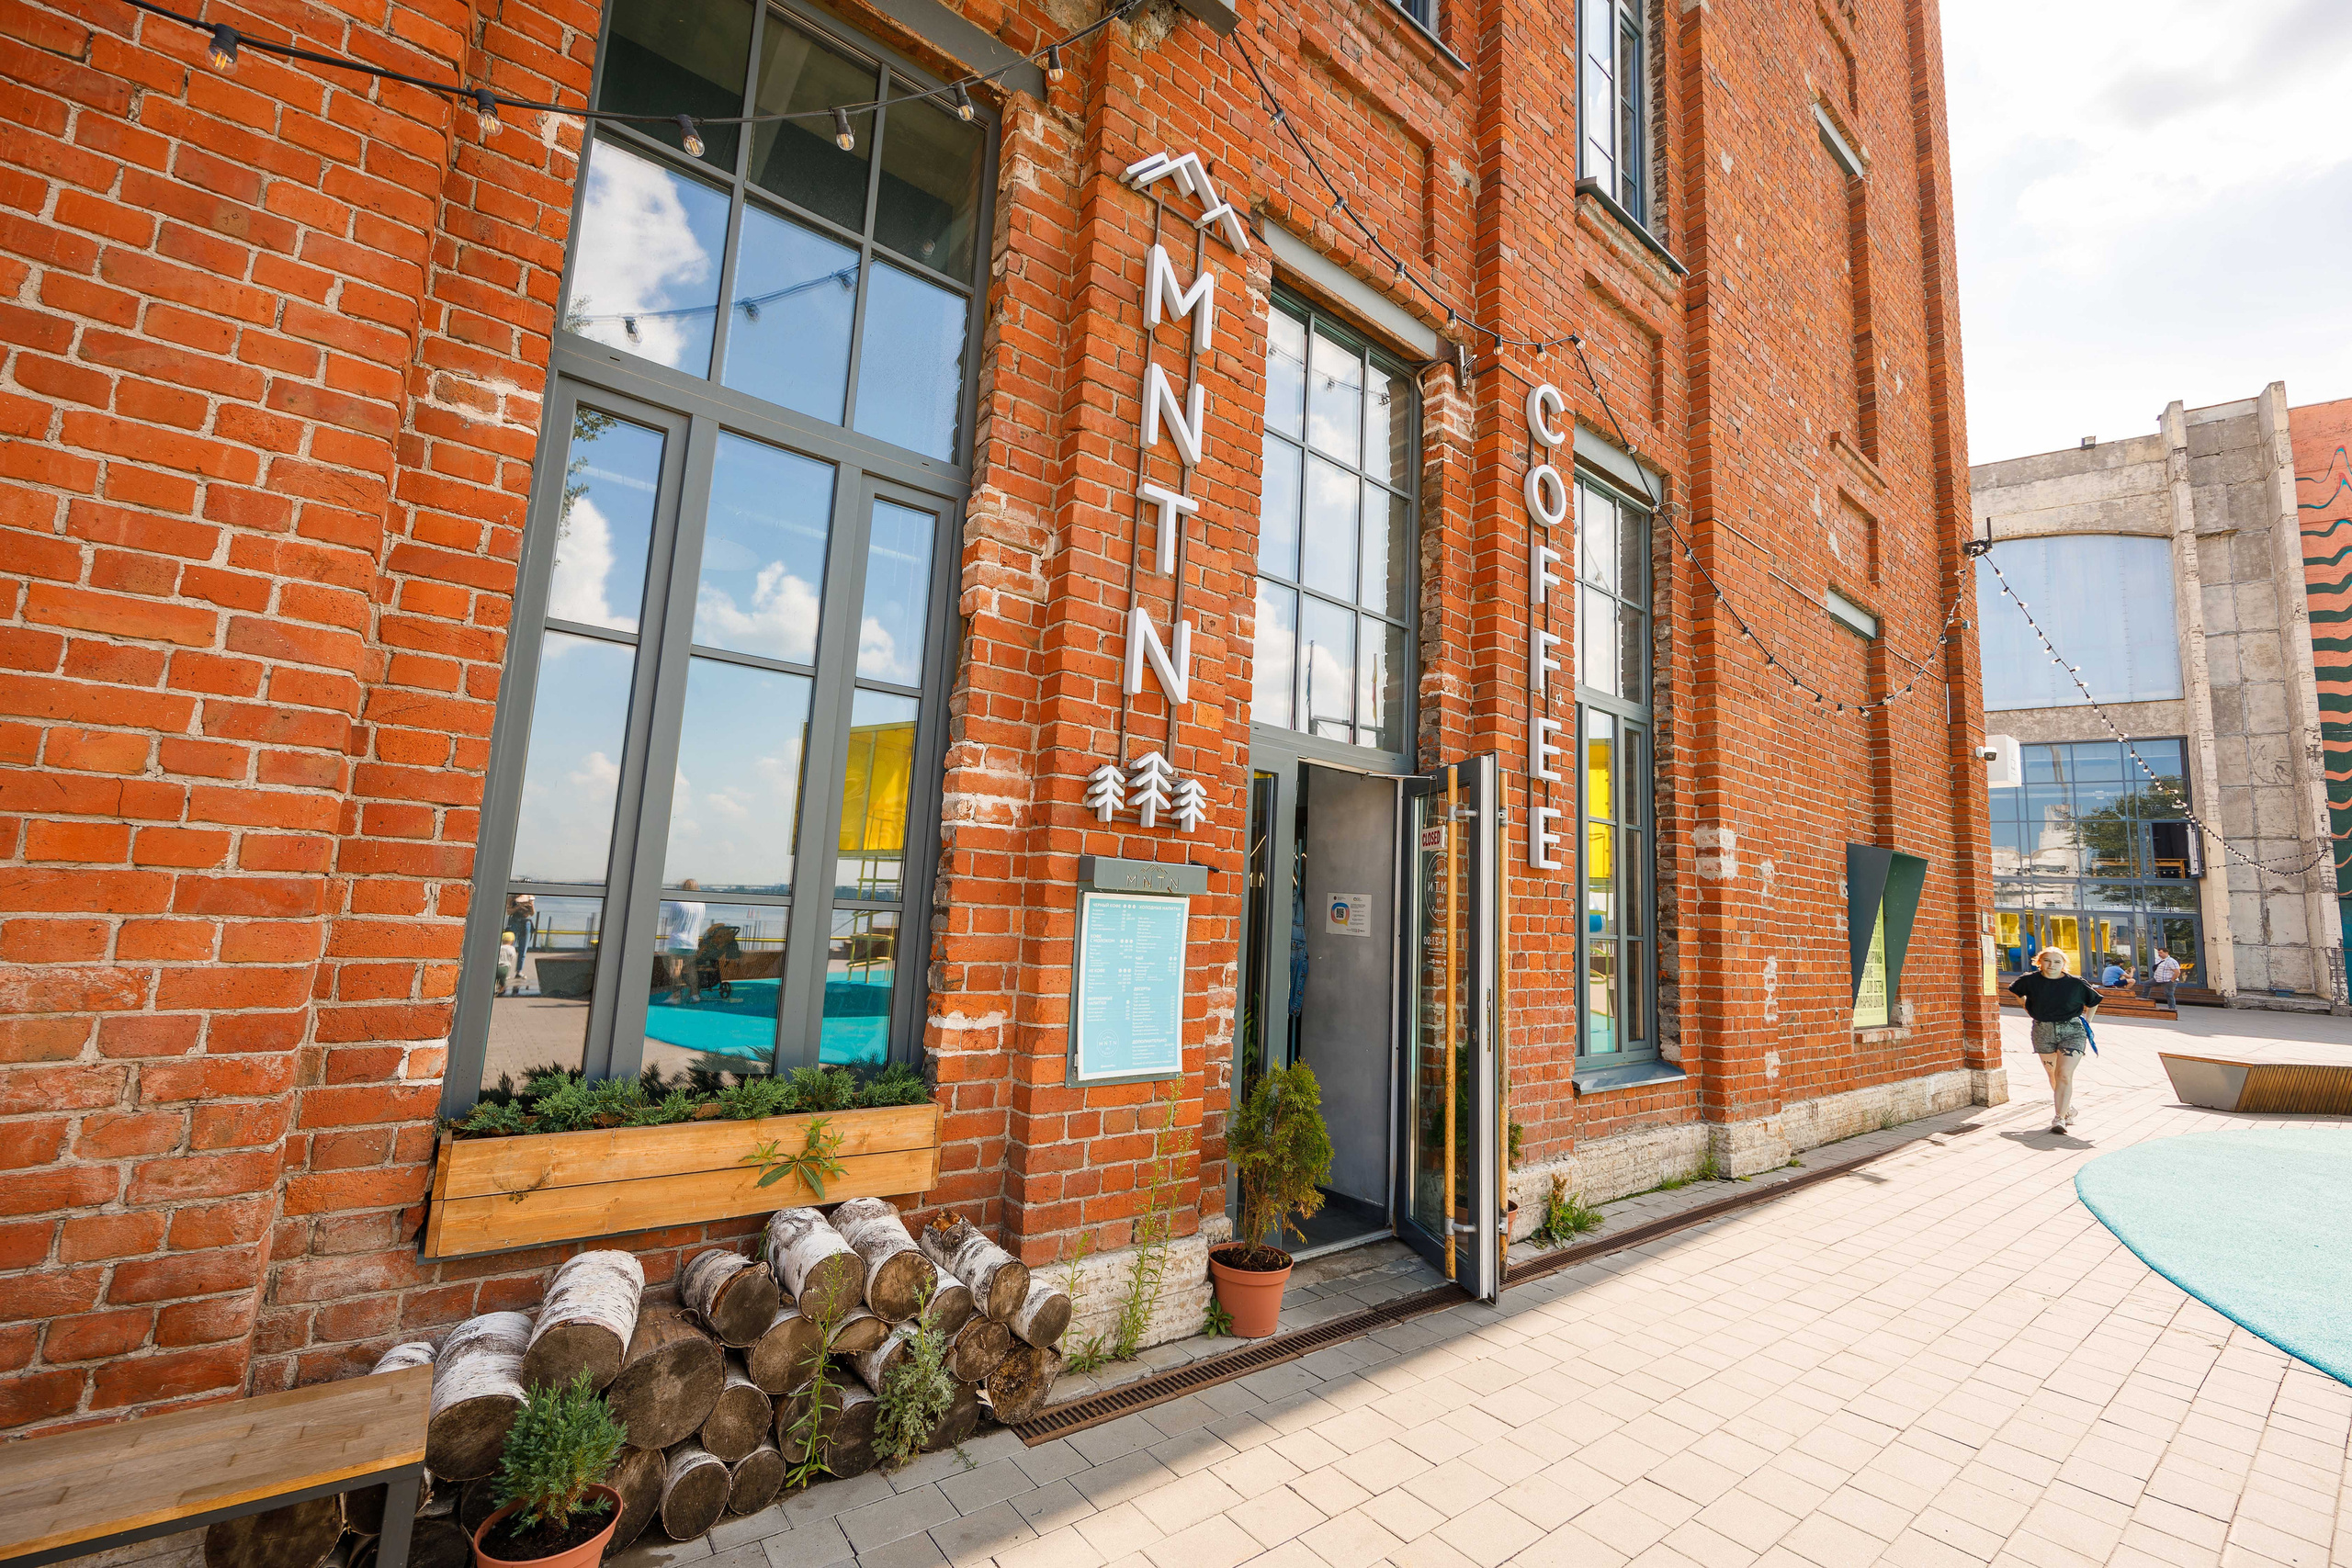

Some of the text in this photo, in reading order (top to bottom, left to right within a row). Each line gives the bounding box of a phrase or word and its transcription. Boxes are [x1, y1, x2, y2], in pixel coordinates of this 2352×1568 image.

[1124, 243, 1215, 705] MNTN
[1523, 384, 1566, 870] COFFEE
[1126, 874, 1180, 890] MNTN
[1422, 830, 1441, 847] CLOSED
